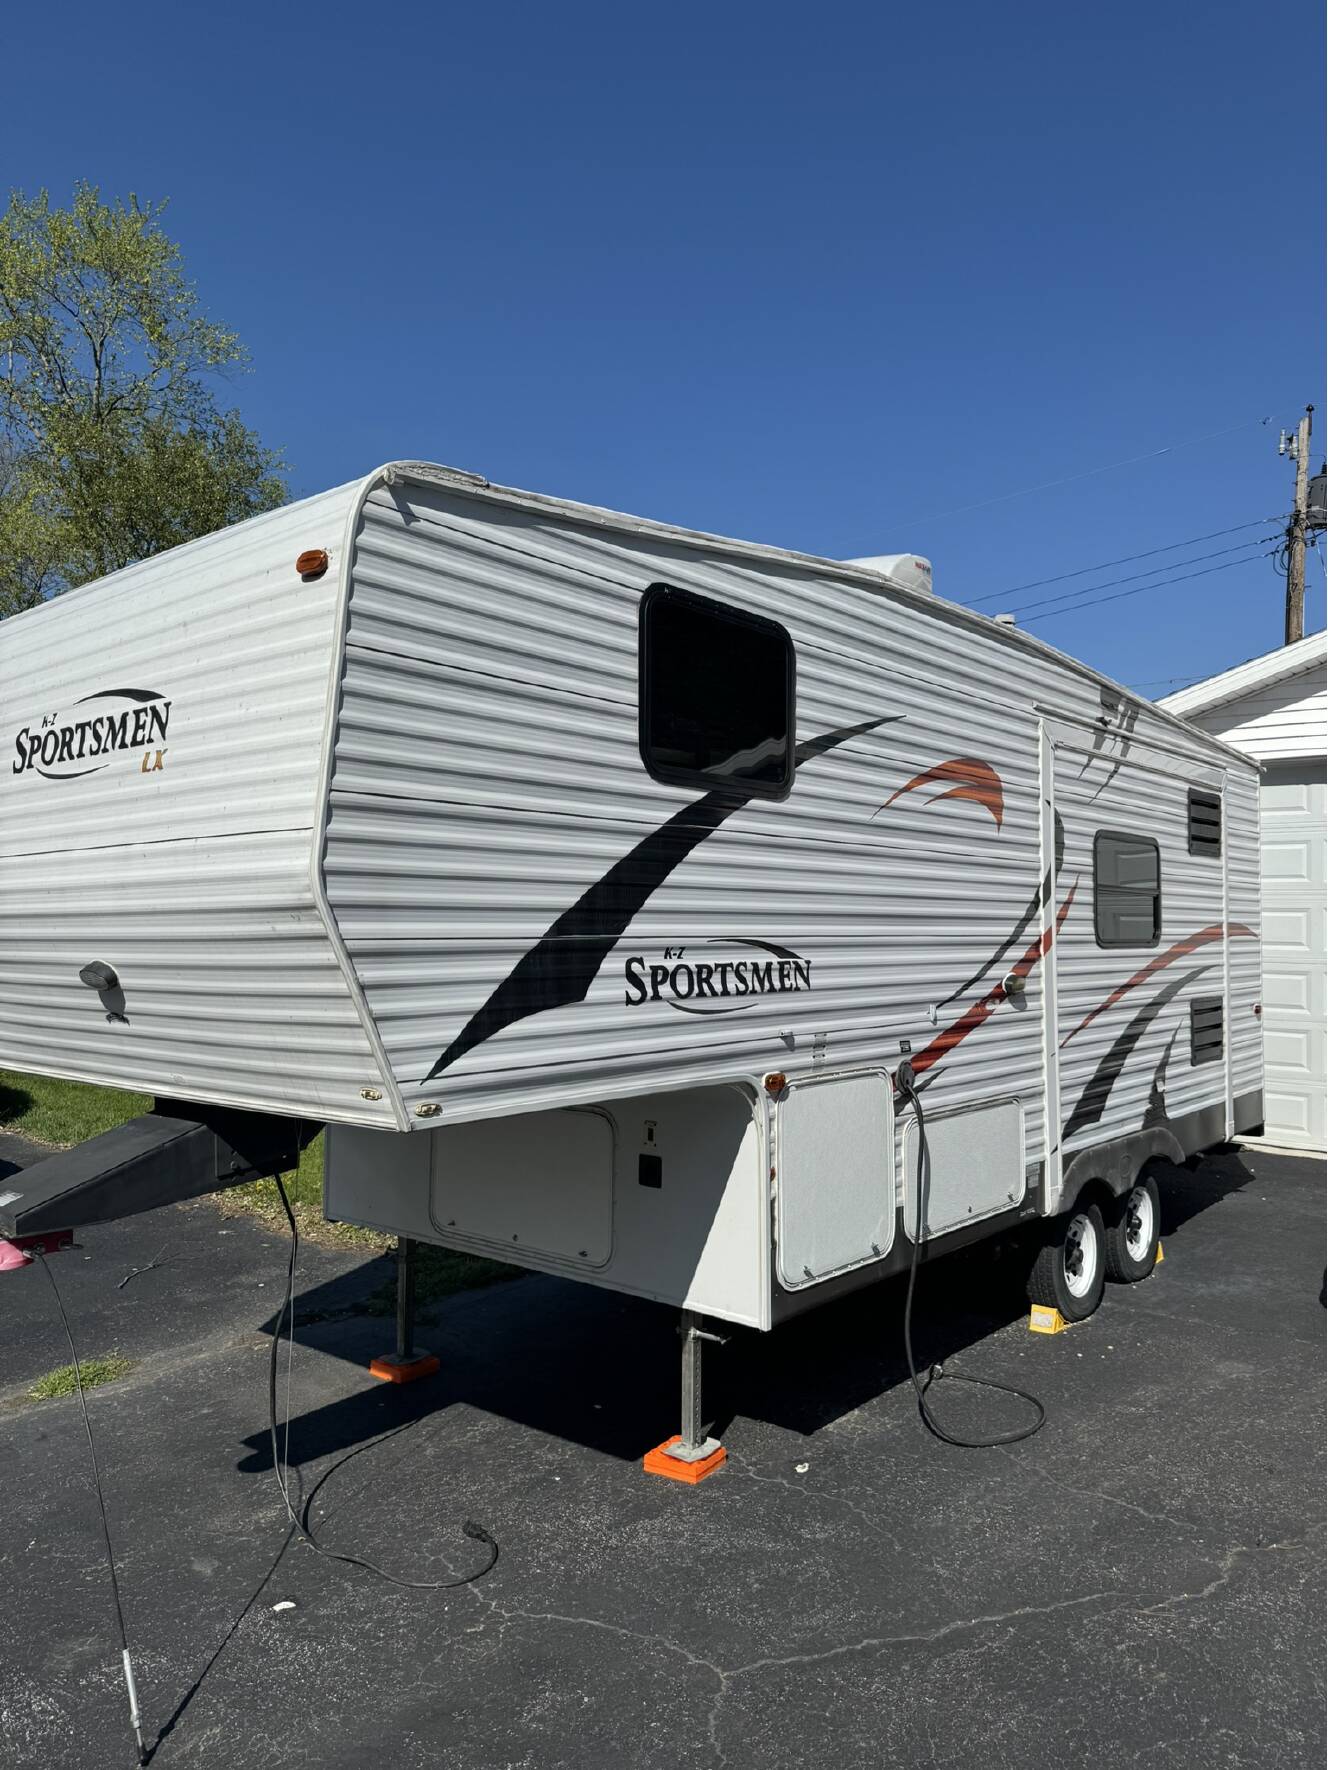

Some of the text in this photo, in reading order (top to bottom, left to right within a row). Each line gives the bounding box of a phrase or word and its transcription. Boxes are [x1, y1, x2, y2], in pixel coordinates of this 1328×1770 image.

[12, 701, 172, 774] SPORTSMEN
[663, 947, 686, 960] K-Z
[625, 956, 811, 1006] SPORTSMEN
